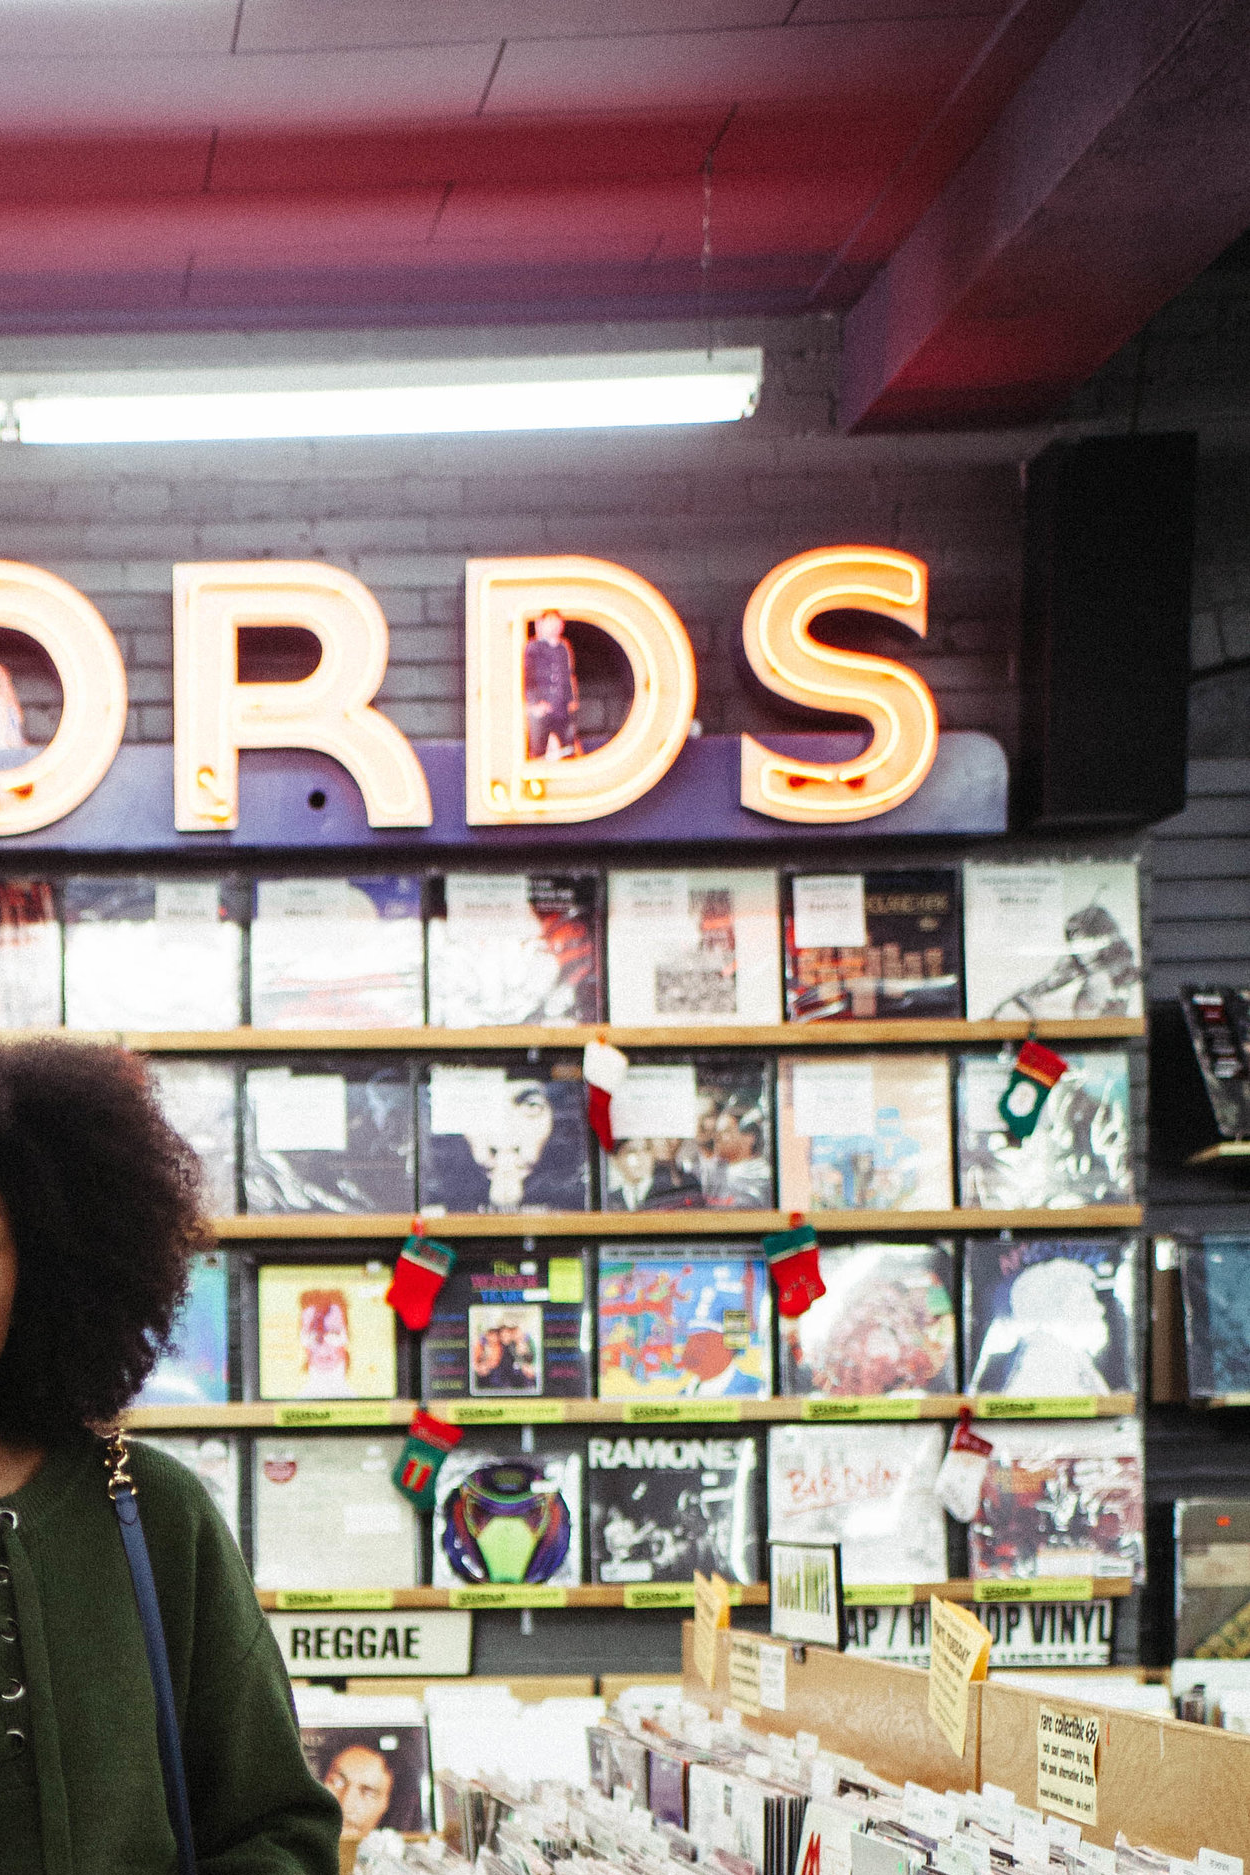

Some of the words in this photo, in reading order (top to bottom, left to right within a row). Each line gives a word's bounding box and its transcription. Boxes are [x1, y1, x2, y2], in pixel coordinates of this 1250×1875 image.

[291, 1626, 421, 1660] REGGAE
[846, 1604, 879, 1648] AP
[1031, 1602, 1112, 1646] VINYL
